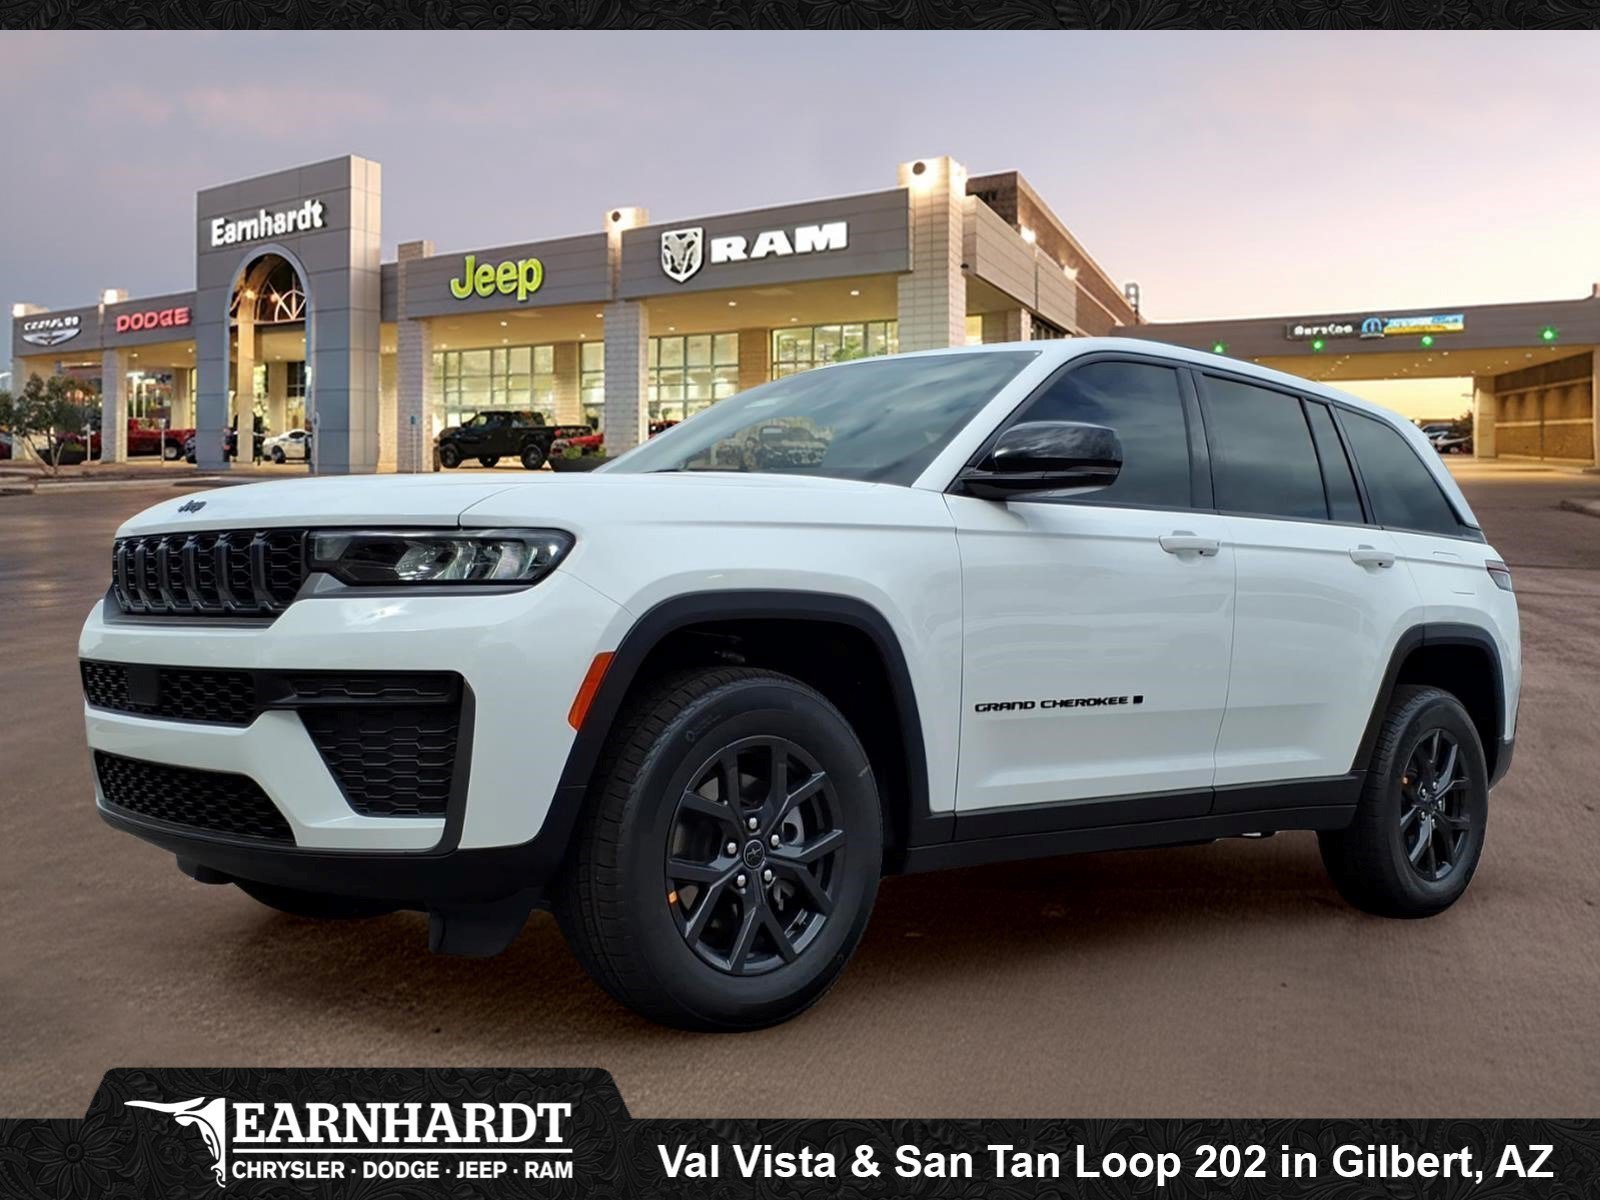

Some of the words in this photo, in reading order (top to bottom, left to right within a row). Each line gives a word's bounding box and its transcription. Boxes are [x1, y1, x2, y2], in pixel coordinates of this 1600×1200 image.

[211, 199, 323, 247] Earnhardt
[711, 221, 848, 263] RAM
[450, 255, 543, 301] Jeep
[116, 307, 190, 332] DODGE
[974, 700, 1036, 713] GRAND
[1040, 696, 1129, 709] CHEROKEE
